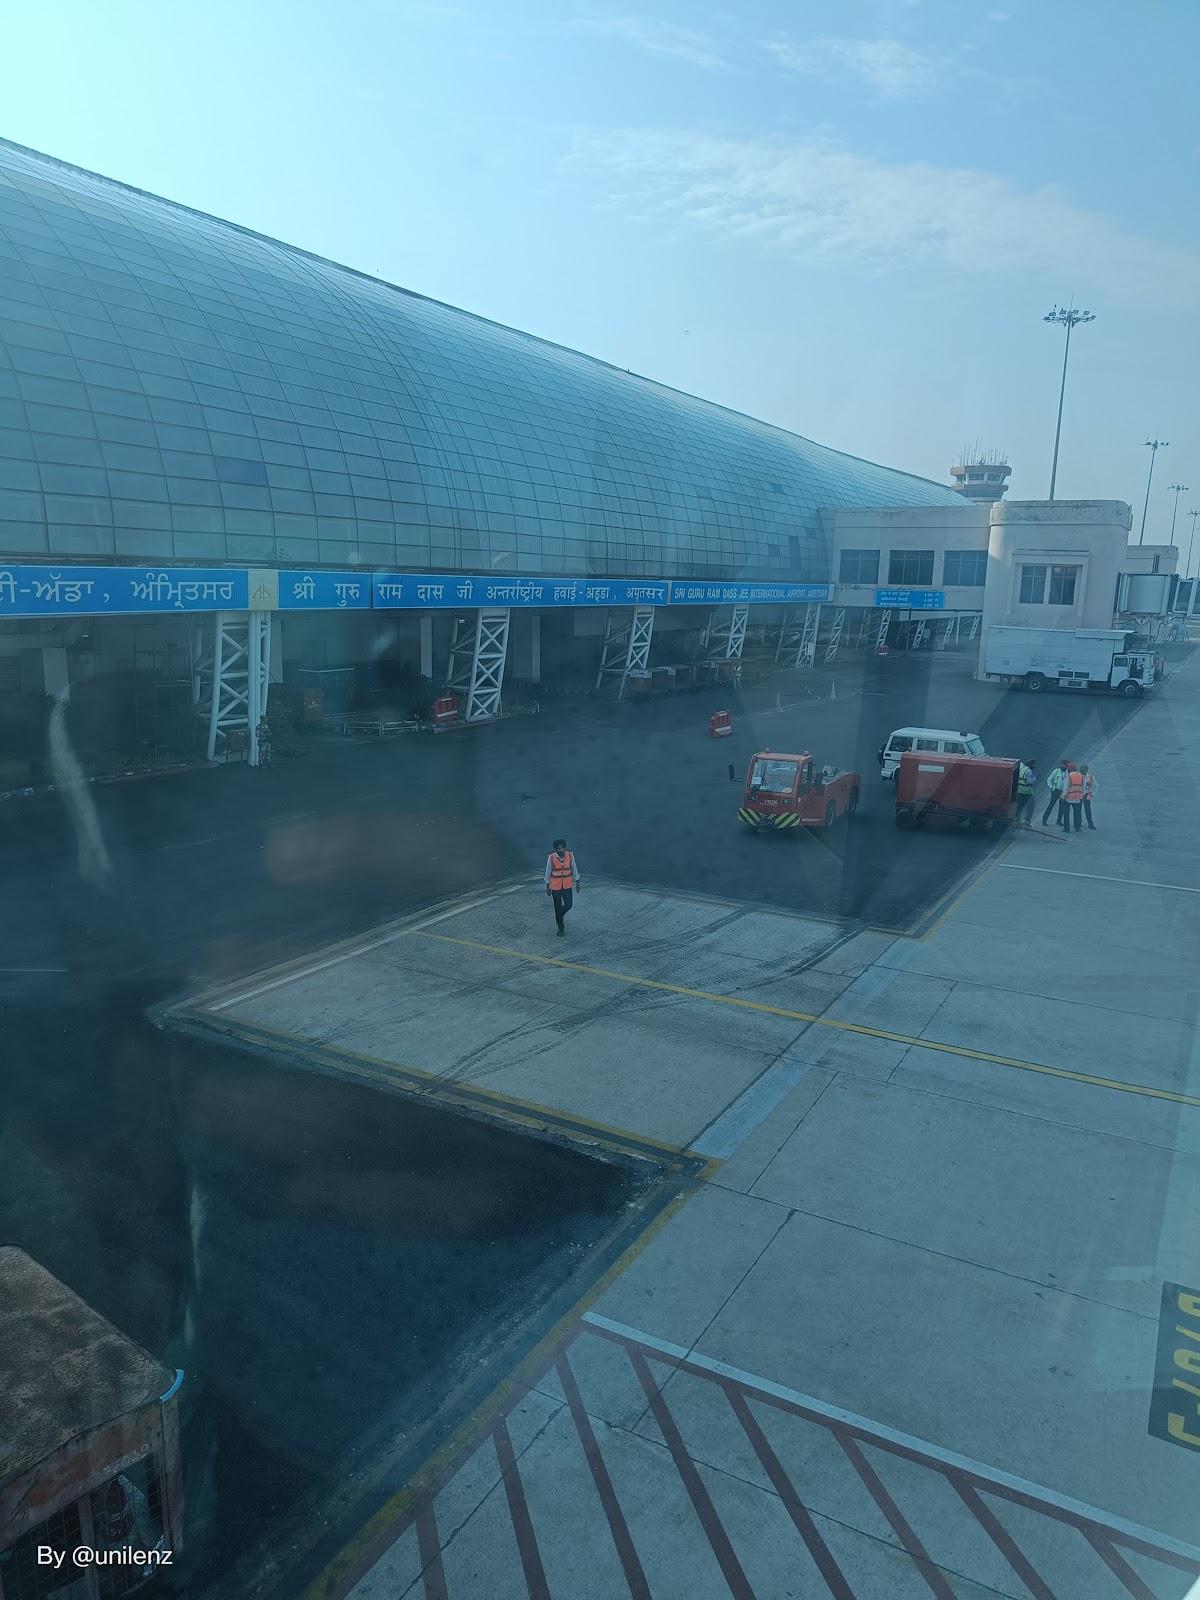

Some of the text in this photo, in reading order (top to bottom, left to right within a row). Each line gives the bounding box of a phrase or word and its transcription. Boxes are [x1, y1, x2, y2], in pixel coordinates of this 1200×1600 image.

[130, 572, 235, 608] ਅੰਮ੍ਰਿਤਸਰ
[293, 576, 316, 600] श्री
[334, 583, 360, 607] गुरु
[377, 584, 403, 600] राम
[417, 584, 444, 601] दास
[456, 580, 473, 600] जी
[626, 587, 665, 602] अमृतसर
[674, 587, 686, 599] SRI
[687, 588, 706, 599] GURU
[706, 588, 721, 599] RAM
[722, 588, 738, 599] DASS
[738, 588, 749, 599] JEE
